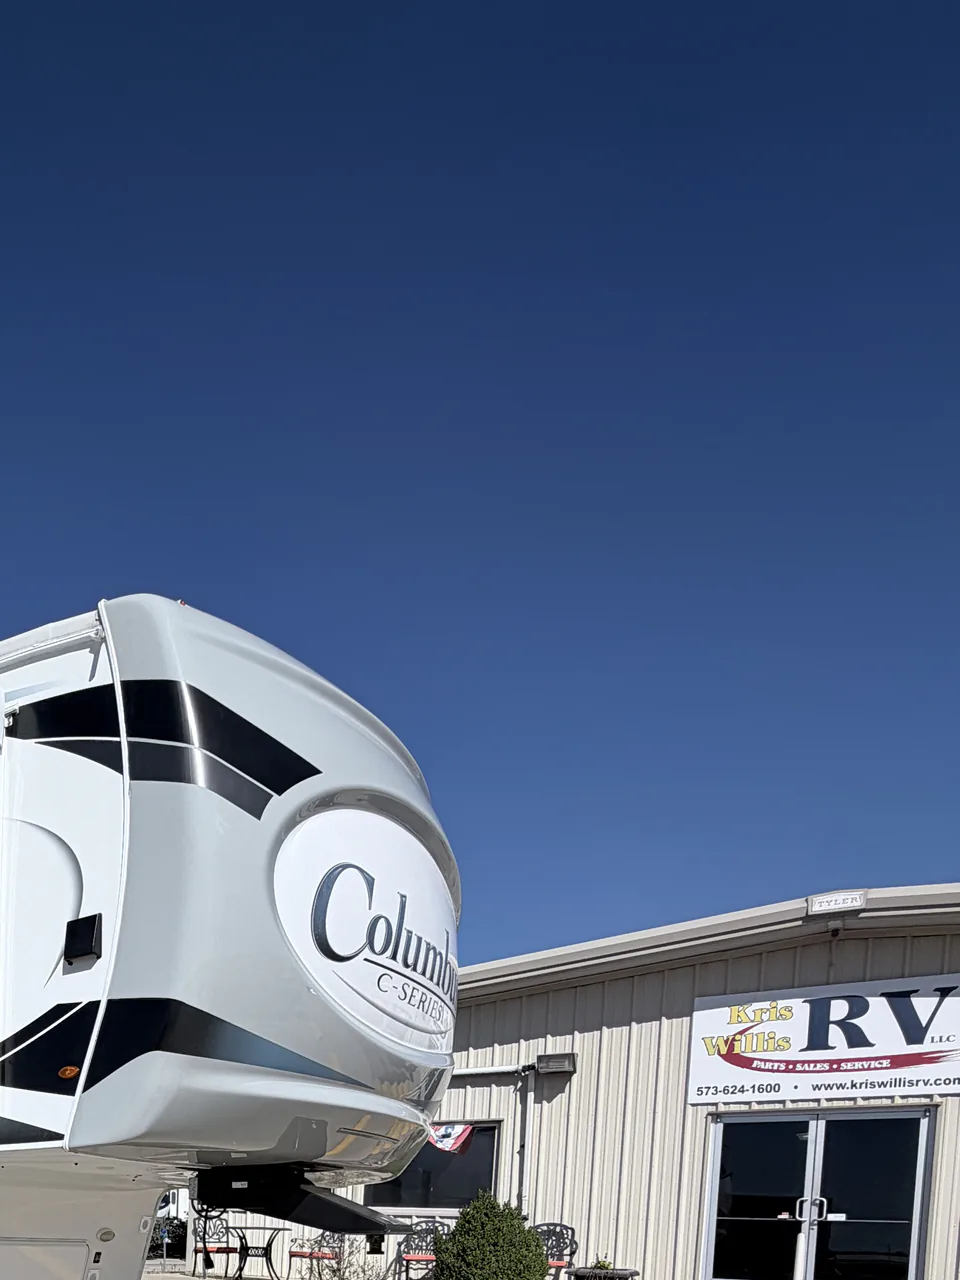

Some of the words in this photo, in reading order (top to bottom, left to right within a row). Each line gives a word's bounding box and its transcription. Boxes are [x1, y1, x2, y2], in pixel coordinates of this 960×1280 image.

[817, 896, 858, 908] TYLER
[311, 862, 457, 1005] Columbu
[377, 972, 444, 1022] C-SERIES
[726, 1000, 794, 1025] Kris
[798, 985, 959, 1053] RV
[930, 1034, 956, 1044] LLC
[701, 1030, 792, 1056] Willis
[751, 1060, 786, 1071] PARTS
[795, 1062, 830, 1071] SALES
[840, 1059, 891, 1070] SERVICE
[696, 1083, 781, 1096] 573-624-1600
